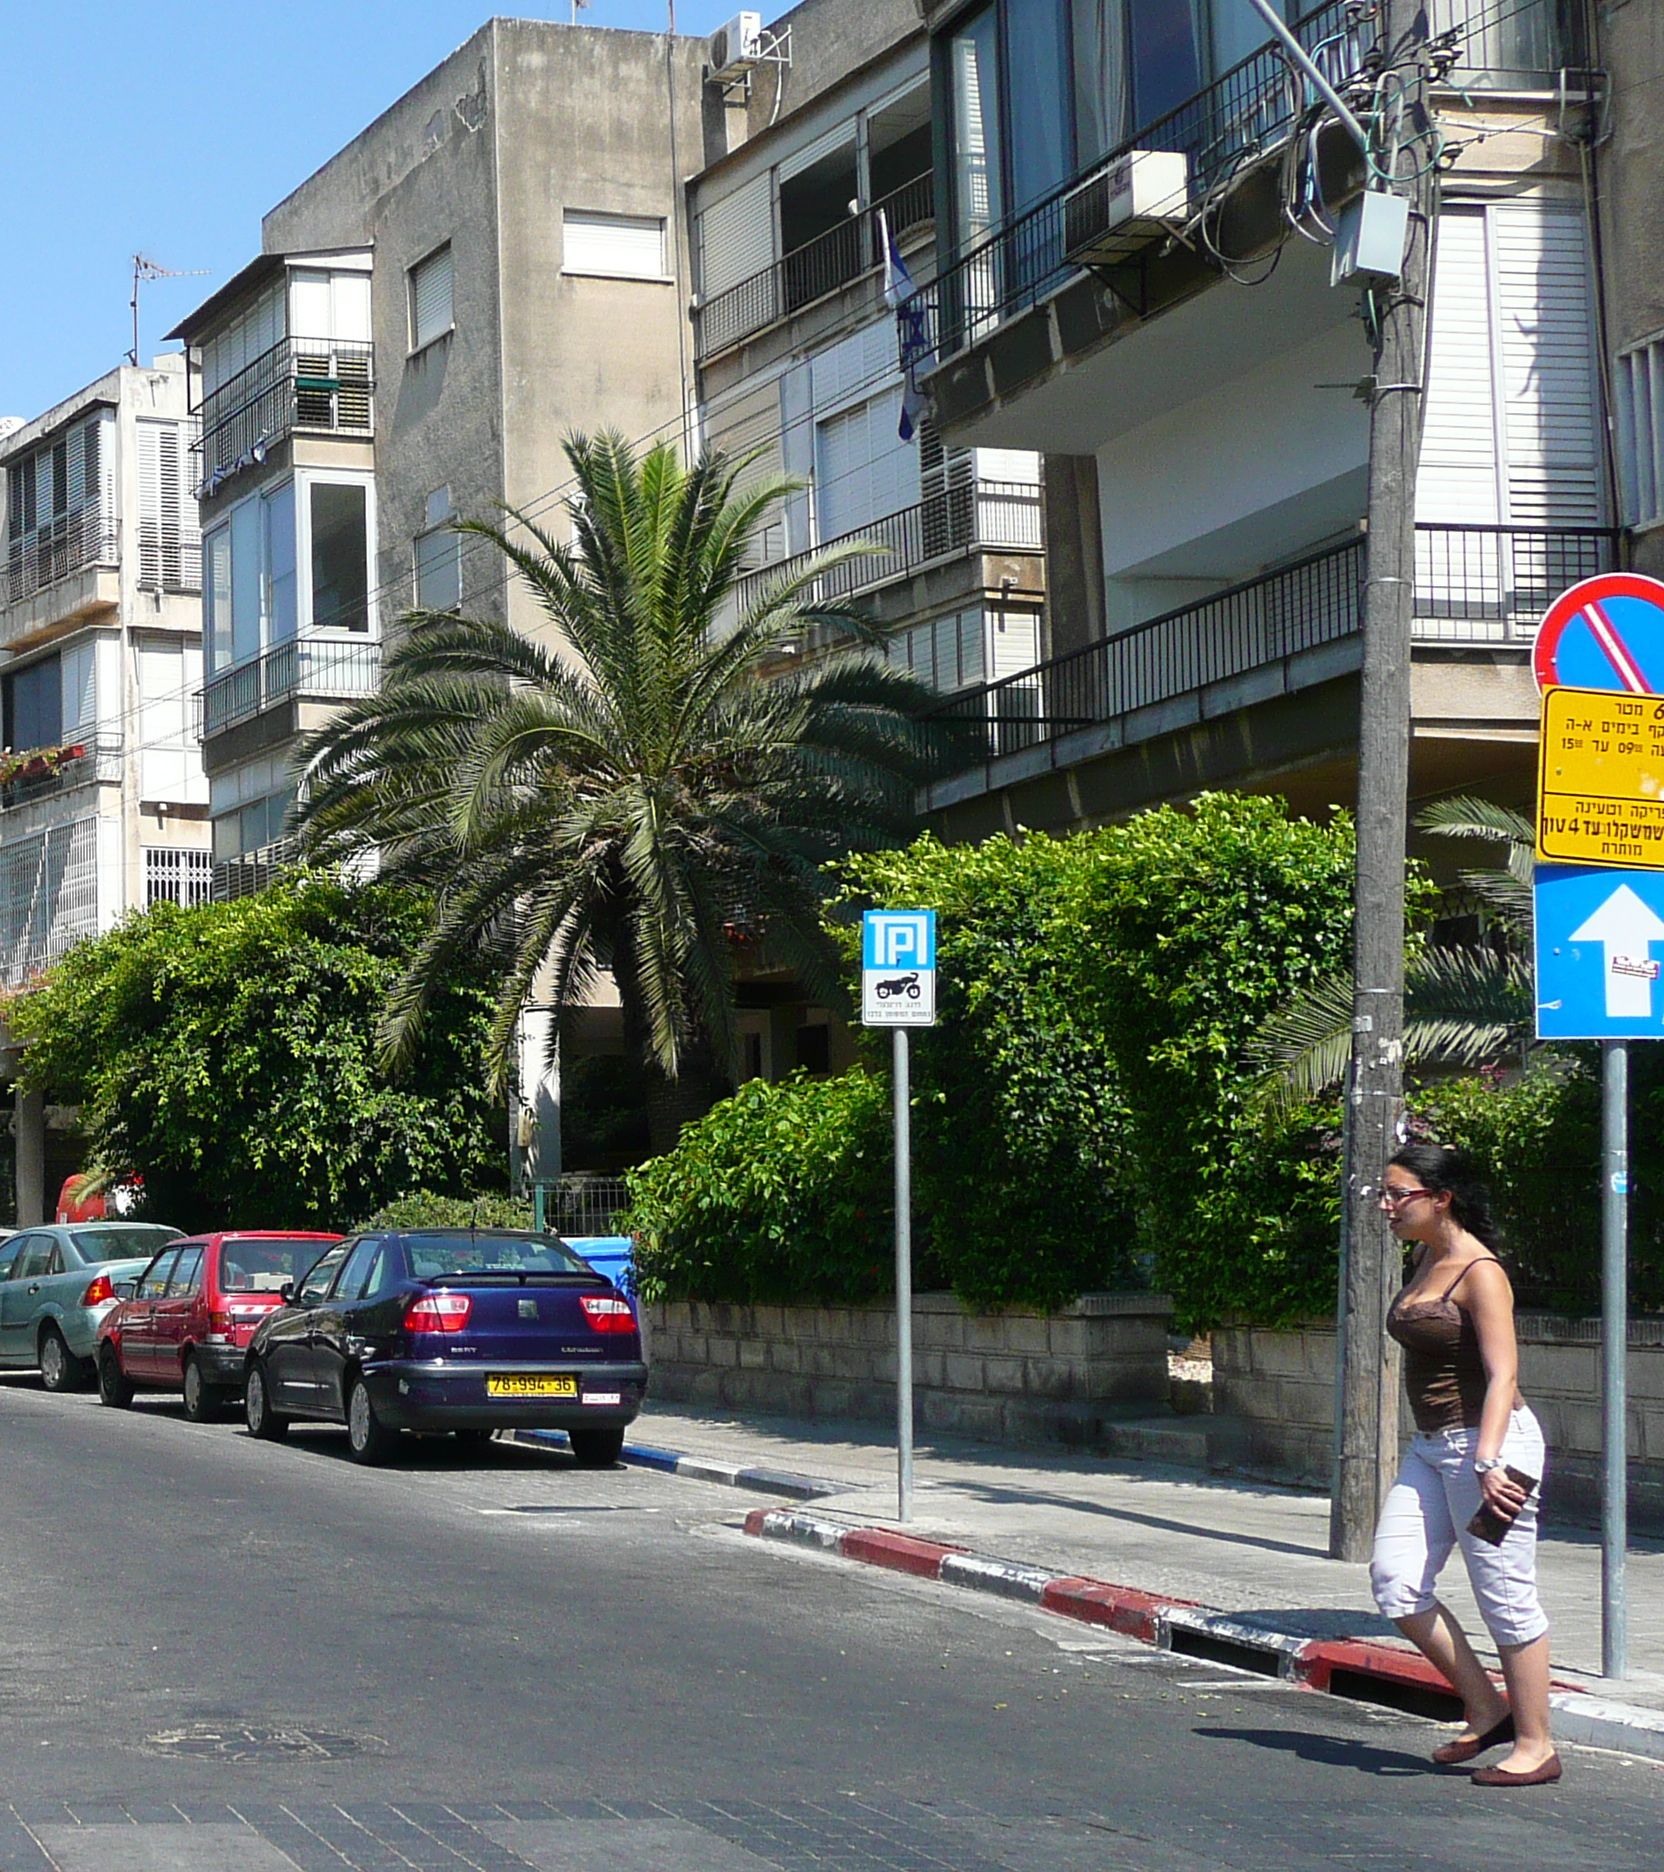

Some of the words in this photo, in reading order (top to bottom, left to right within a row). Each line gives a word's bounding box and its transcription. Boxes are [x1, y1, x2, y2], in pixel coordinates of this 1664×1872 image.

[1615, 703, 1643, 716] מטר
[1602, 721, 1639, 735] בימים
[1592, 740, 1609, 752] עד
[1576, 801, 1622, 816] וטעינה
[1569, 818, 1580, 835] 4
[1583, 820, 1600, 836] עד
[1602, 842, 1642, 856] מותרת
[492, 1376, 571, 1392] 78-994-36
